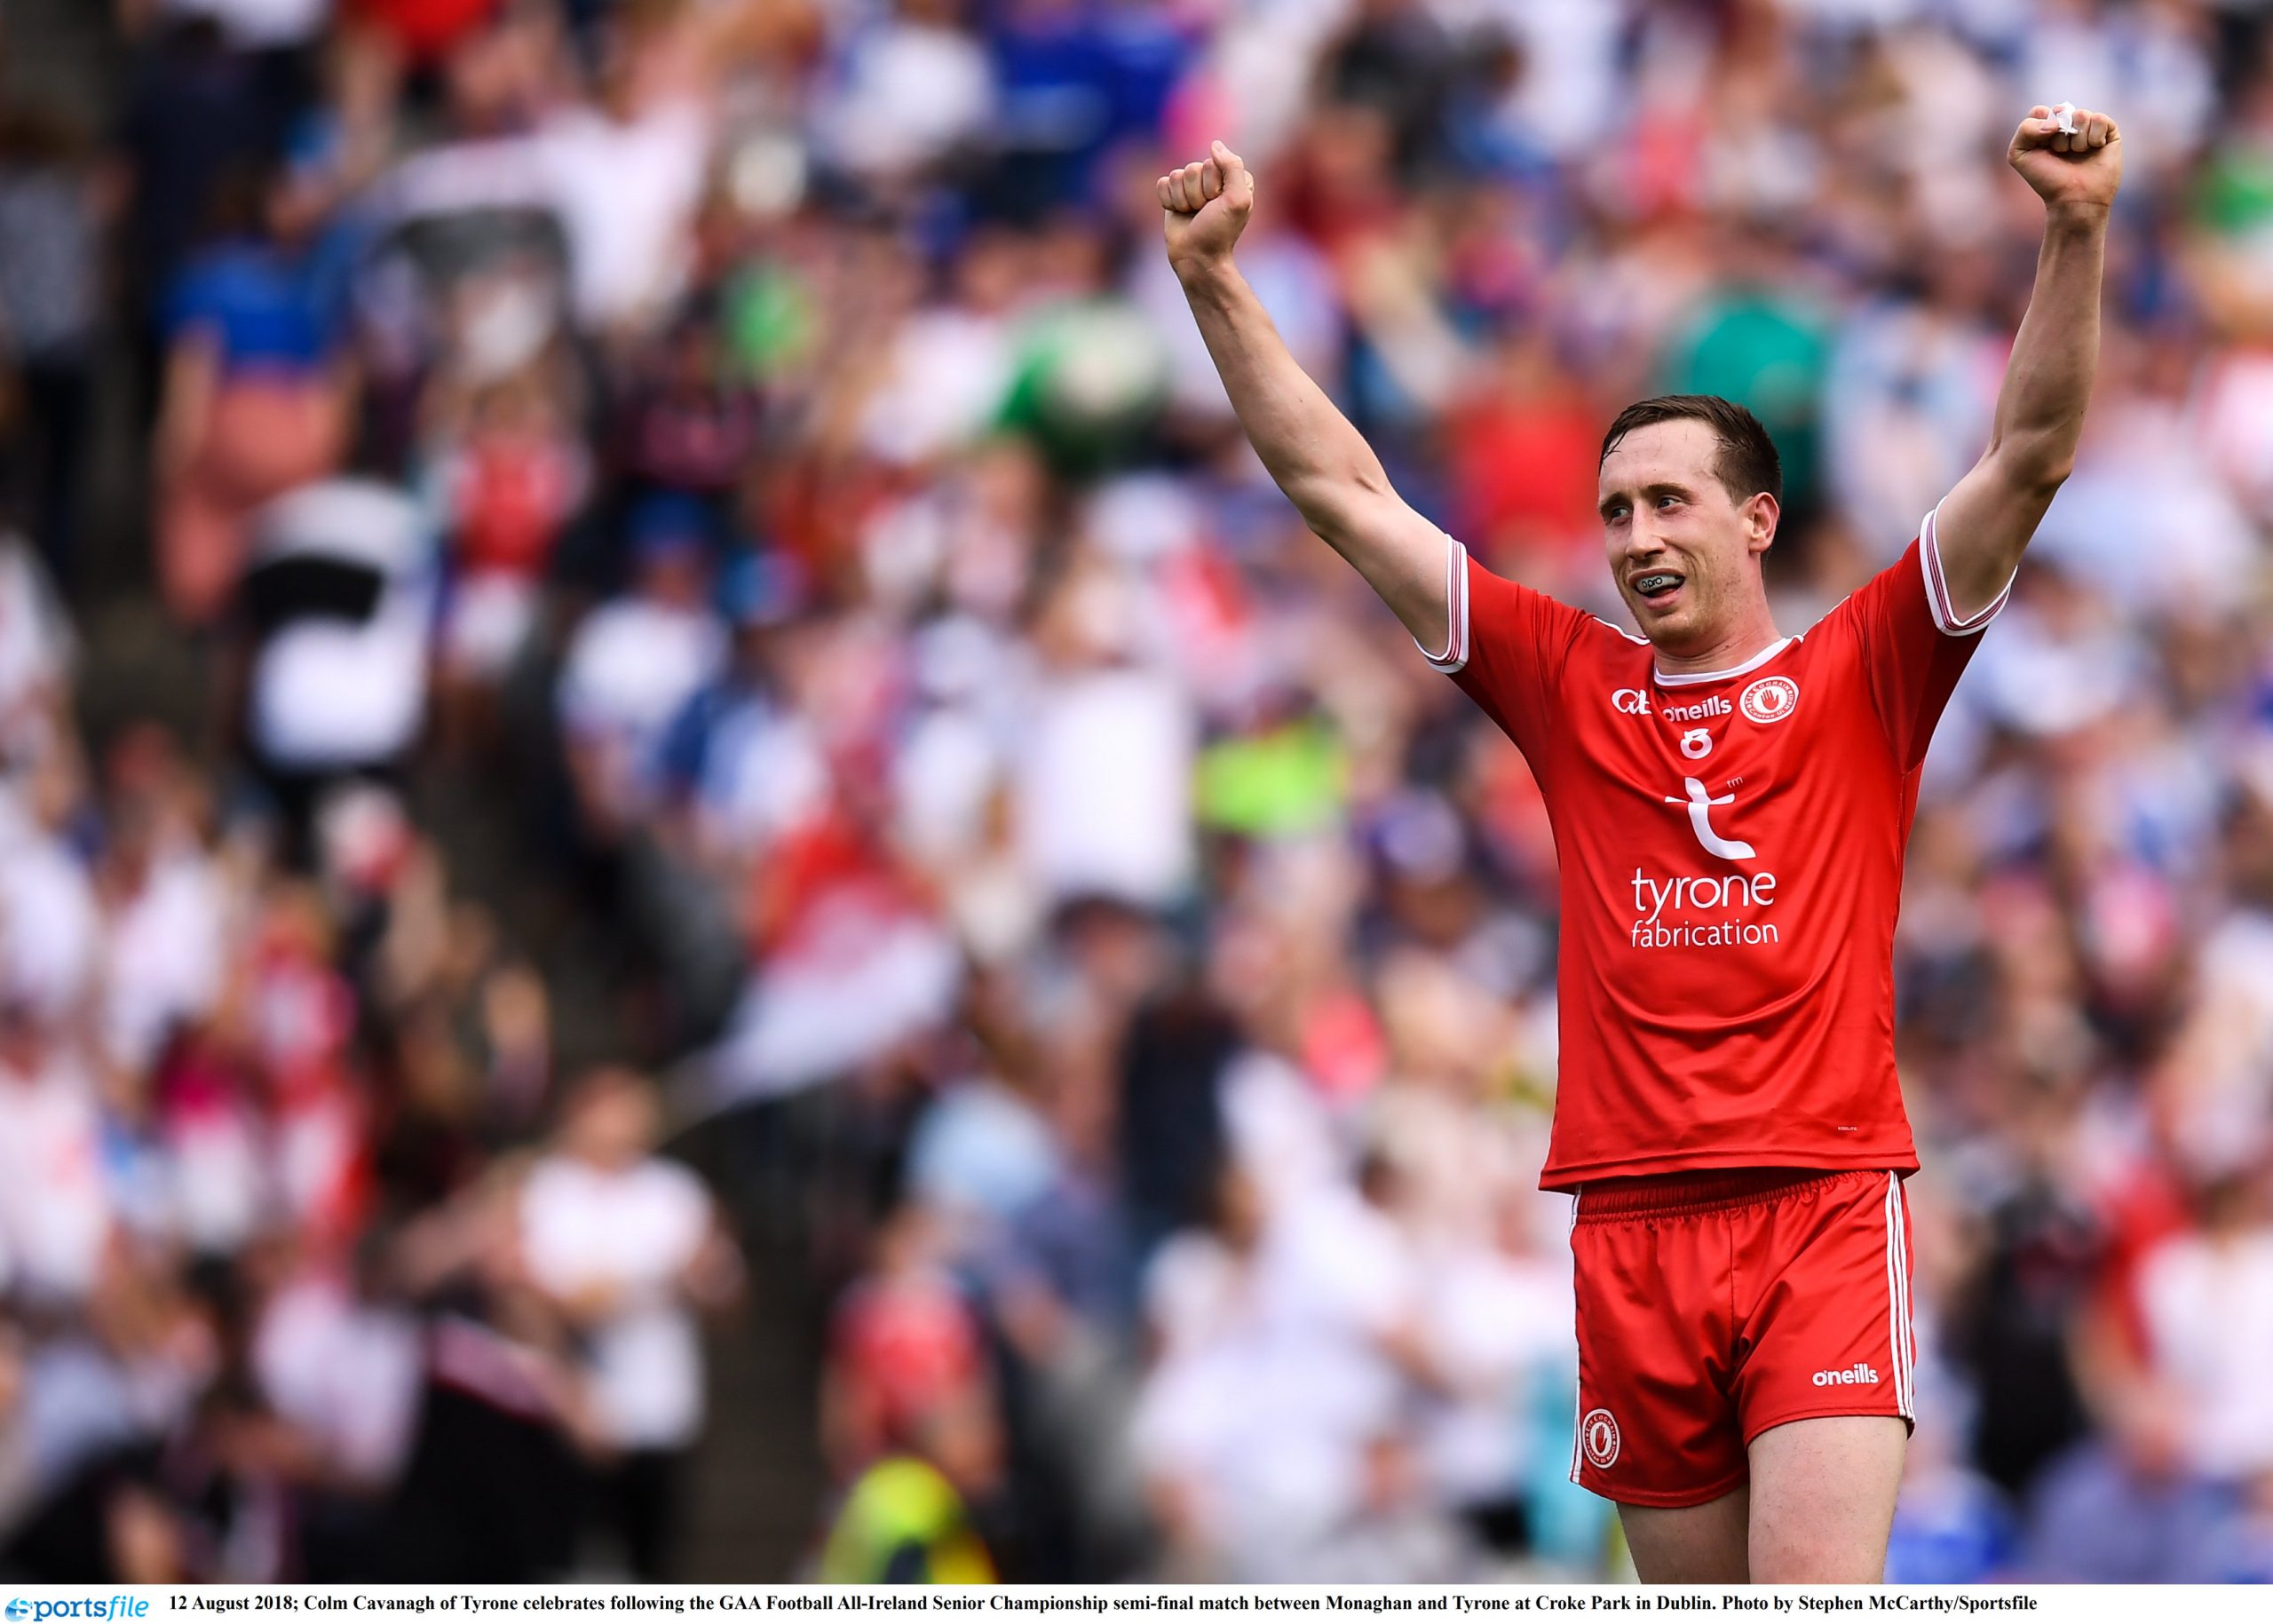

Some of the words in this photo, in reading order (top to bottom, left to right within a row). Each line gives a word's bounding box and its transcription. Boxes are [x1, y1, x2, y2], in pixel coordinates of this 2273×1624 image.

[1631, 867, 1777, 925] tyrone
[1631, 918, 1779, 948] fabrication
[1812, 1363, 1879, 1386] o'neills
